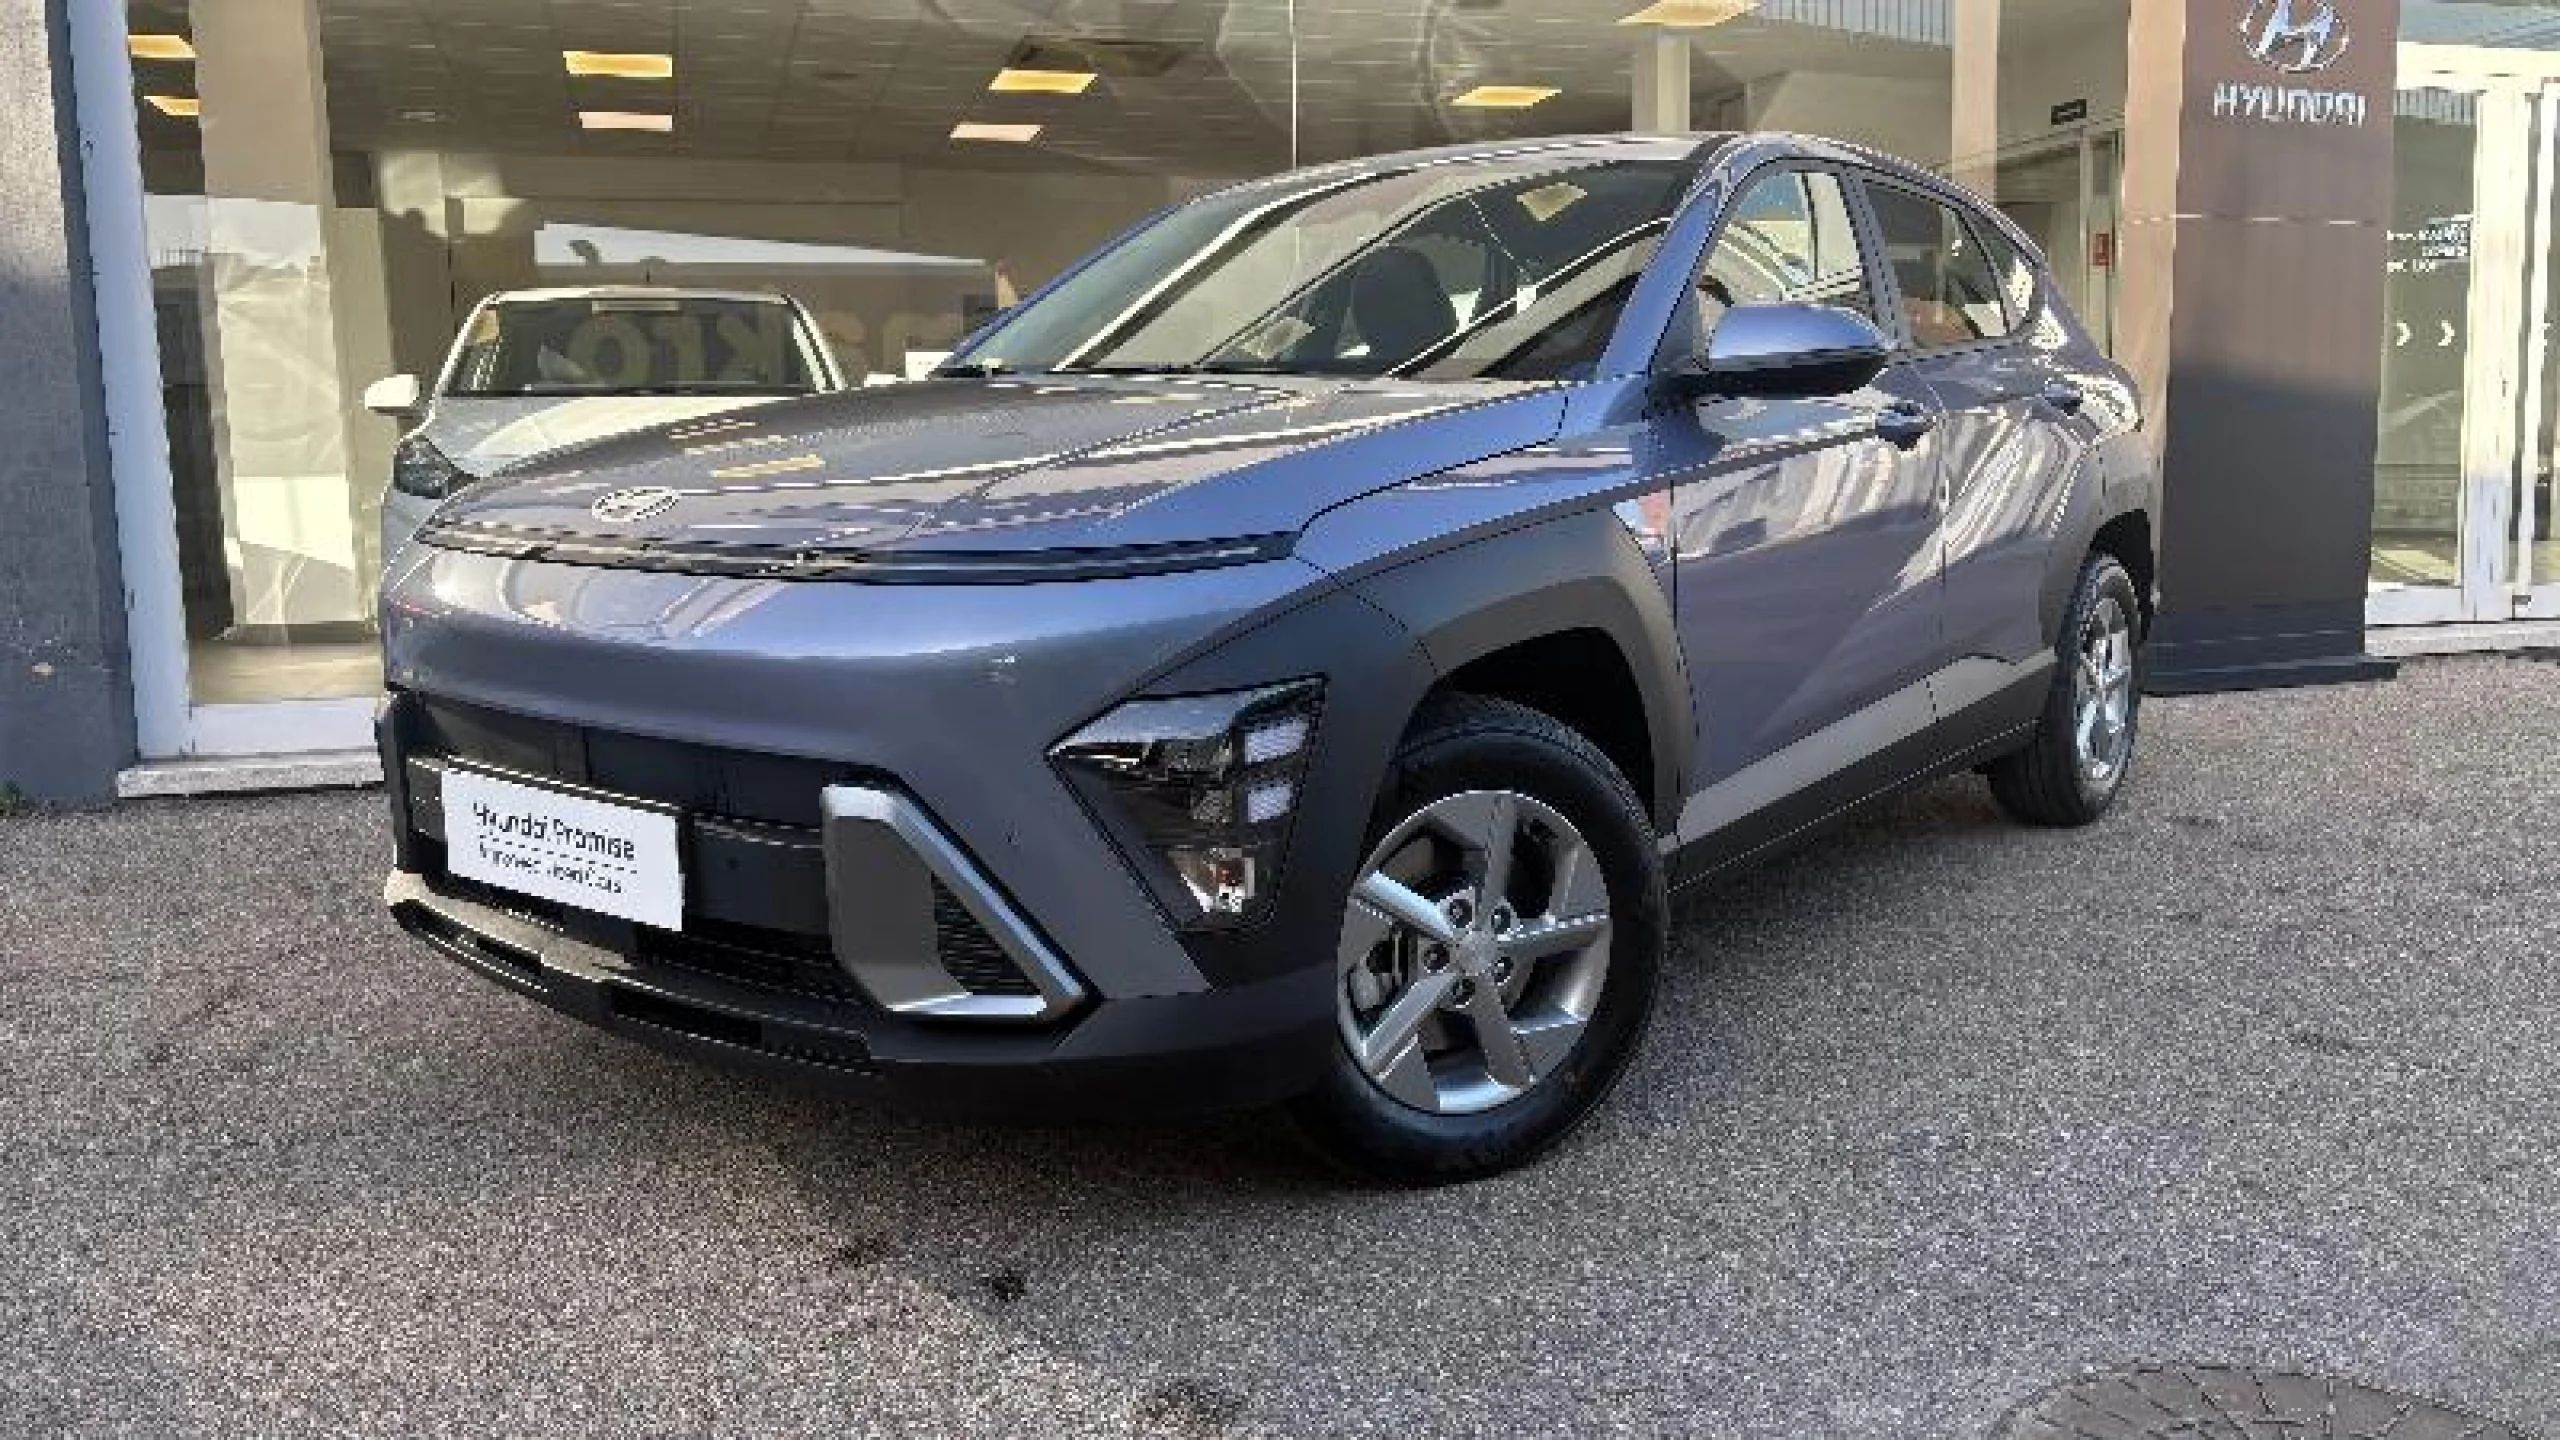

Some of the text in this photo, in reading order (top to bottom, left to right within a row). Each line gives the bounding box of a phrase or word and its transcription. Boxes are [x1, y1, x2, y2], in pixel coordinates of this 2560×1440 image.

[2213, 82, 2366, 128] HYUNDAI
[473, 802, 635, 861] Hyundai Promise
